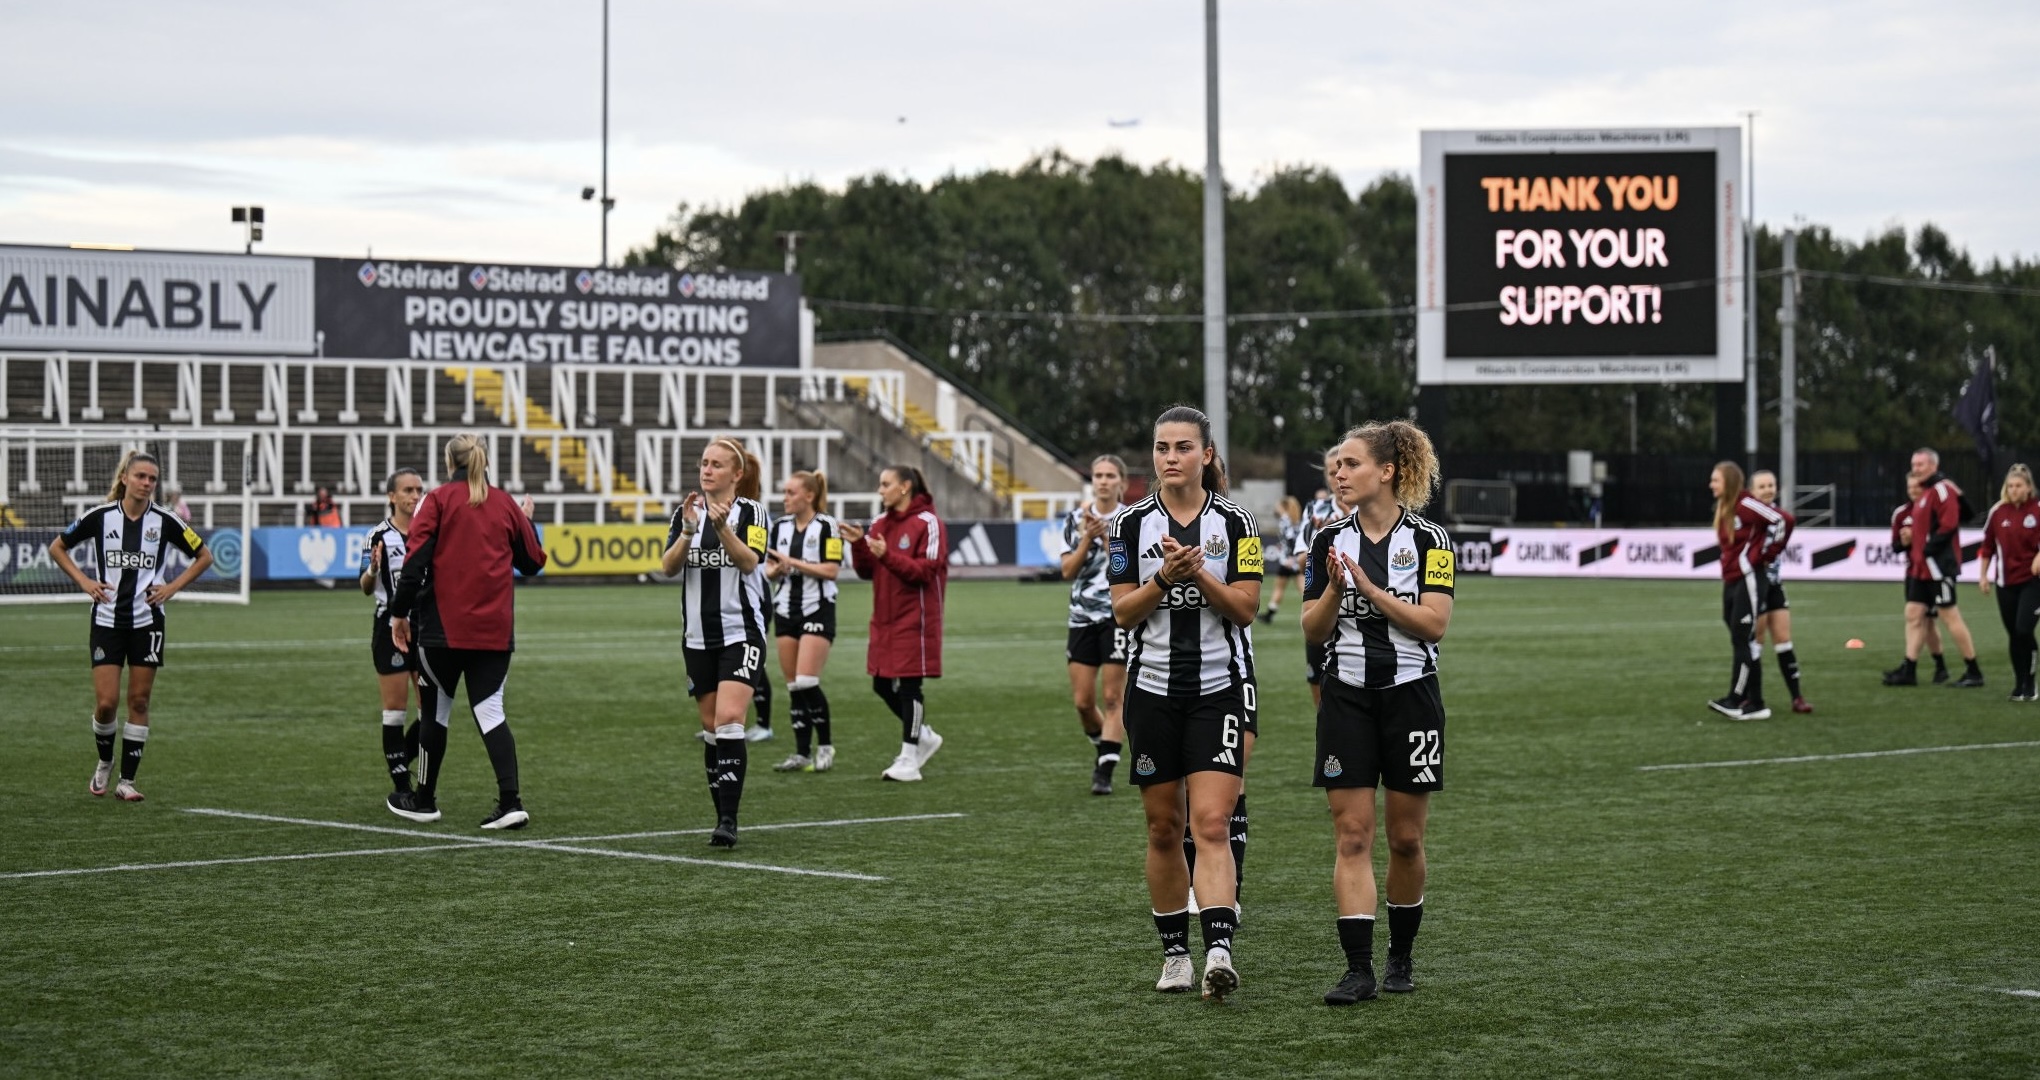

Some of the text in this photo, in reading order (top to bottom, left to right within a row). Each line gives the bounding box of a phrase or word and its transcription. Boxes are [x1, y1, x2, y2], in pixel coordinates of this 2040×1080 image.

[1481, 175, 1678, 212] THANK YOU
[1496, 228, 1669, 269] FOR YOUR
[377, 262, 769, 300] Stelrad Stelrad Stelrad Stelrad
[0, 274, 277, 331] AINABLY
[405, 296, 749, 334] PROUDLY SUPPORTING
[1499, 284, 1662, 325] SUPPORT!
[409, 330, 742, 366] NEWCASTLE FALCONS
[121, 552, 156, 569] sela
[588, 536, 663, 561] noon
[1516, 541, 1573, 563] CARLING
[1627, 542, 1685, 564] CARLING
[1428, 570, 1453, 582] noon
[149, 631, 163, 653] 17
[1113, 628, 1126, 650] 5
[742, 643, 761, 671] 19
[1222, 714, 1239, 749] 6
[1409, 730, 1441, 766] 22
[1160, 931, 1183, 940] NUFC
[1211, 921, 1234, 932] NUFC
